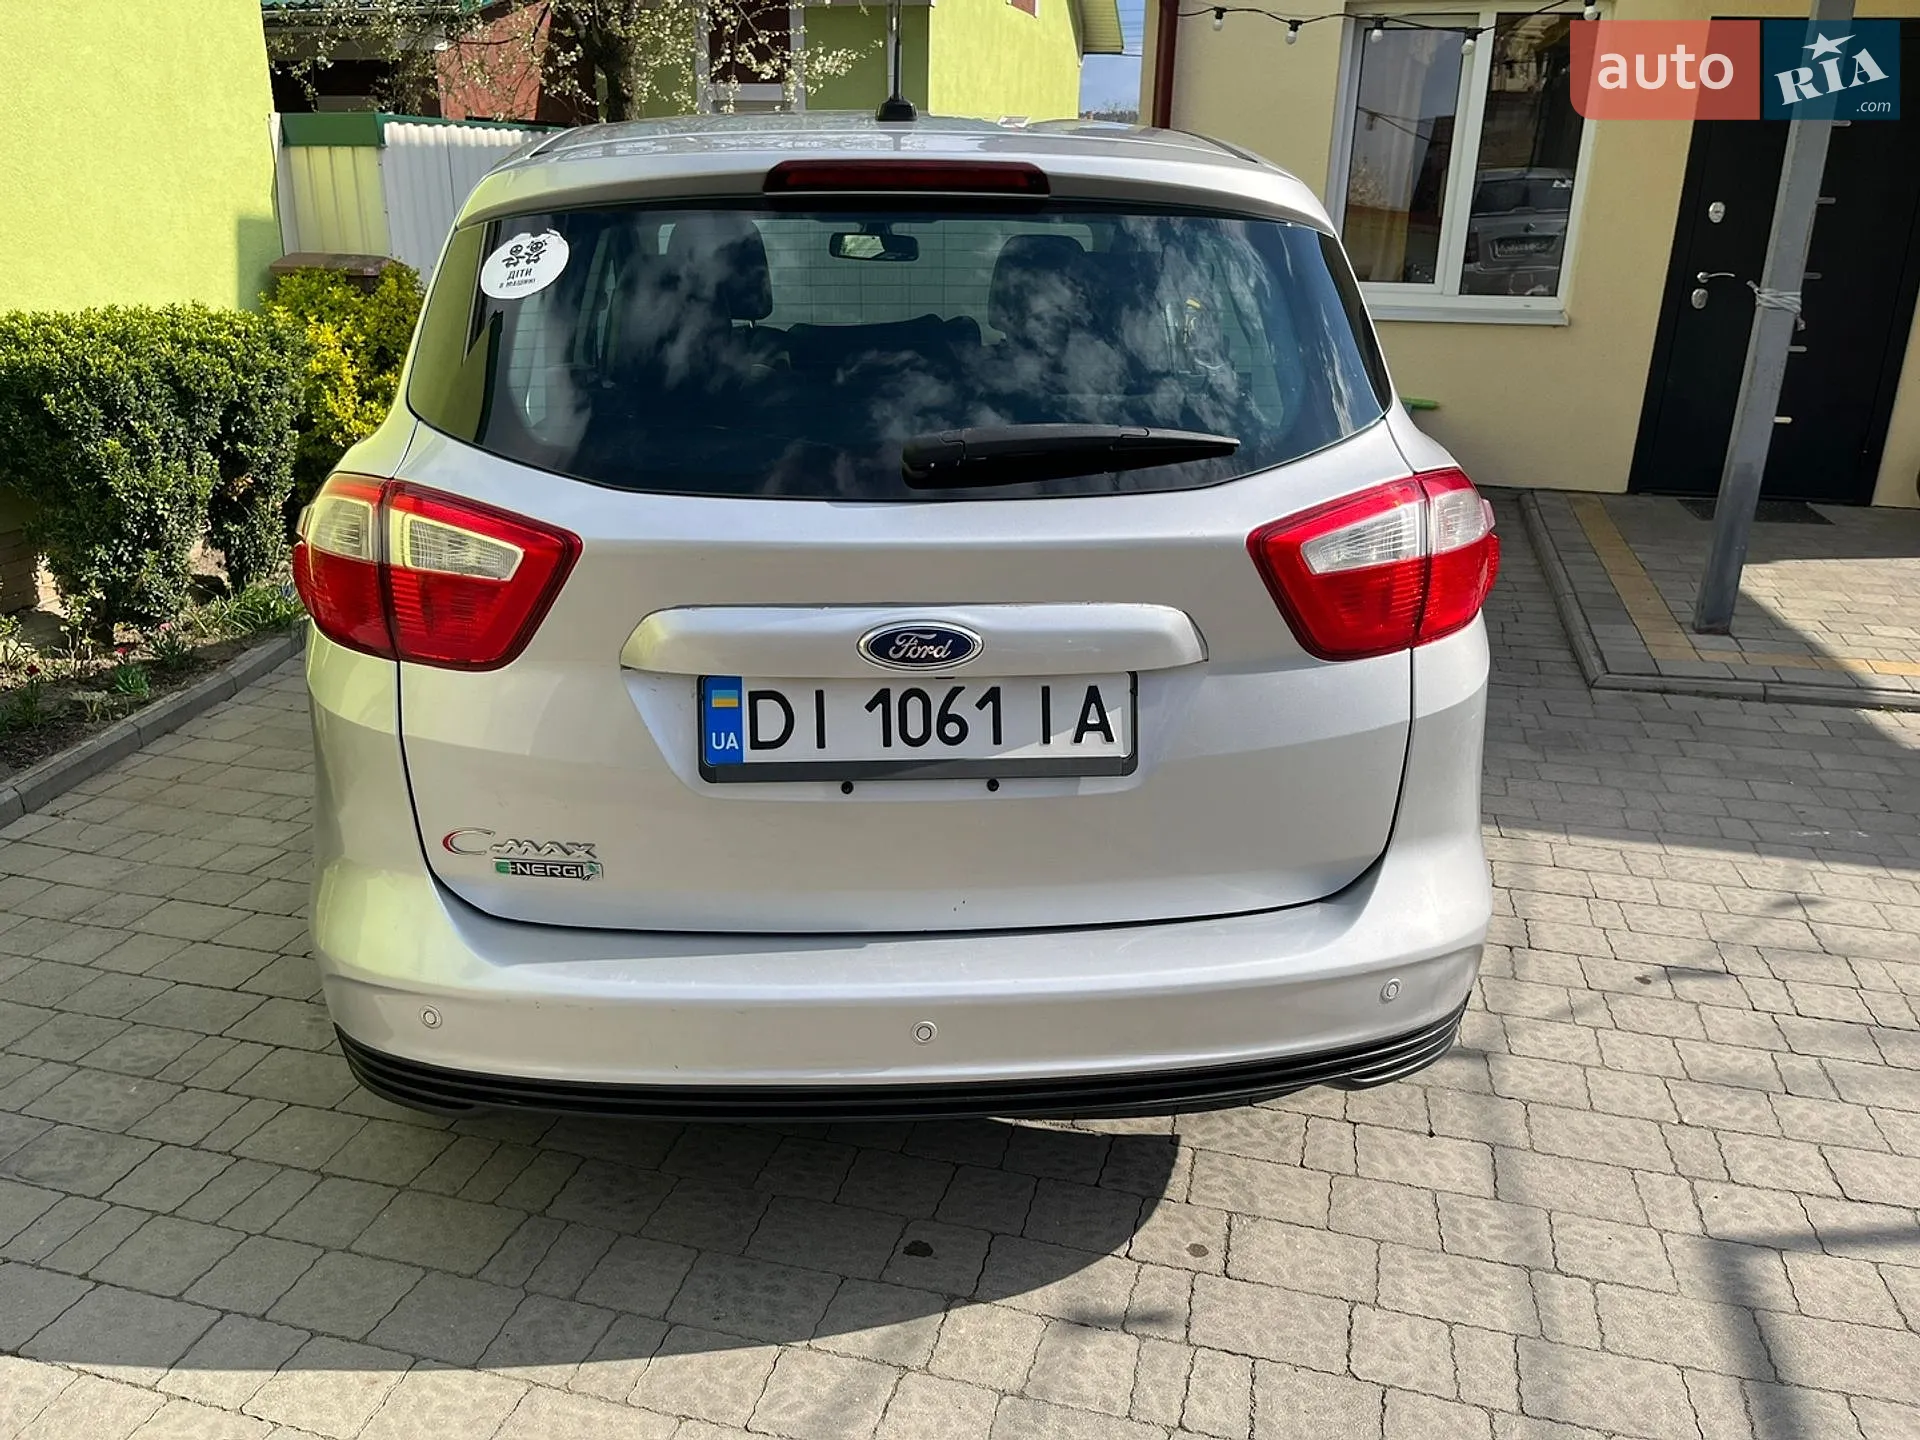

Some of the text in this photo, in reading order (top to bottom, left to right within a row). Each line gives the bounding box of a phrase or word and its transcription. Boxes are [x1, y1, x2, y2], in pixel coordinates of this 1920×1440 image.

[506, 267, 533, 280] ДІТИ
[888, 632, 953, 660] Ford
[711, 731, 739, 751] UA
[864, 685, 1003, 749] 1061
[1041, 684, 1116, 745] IA
